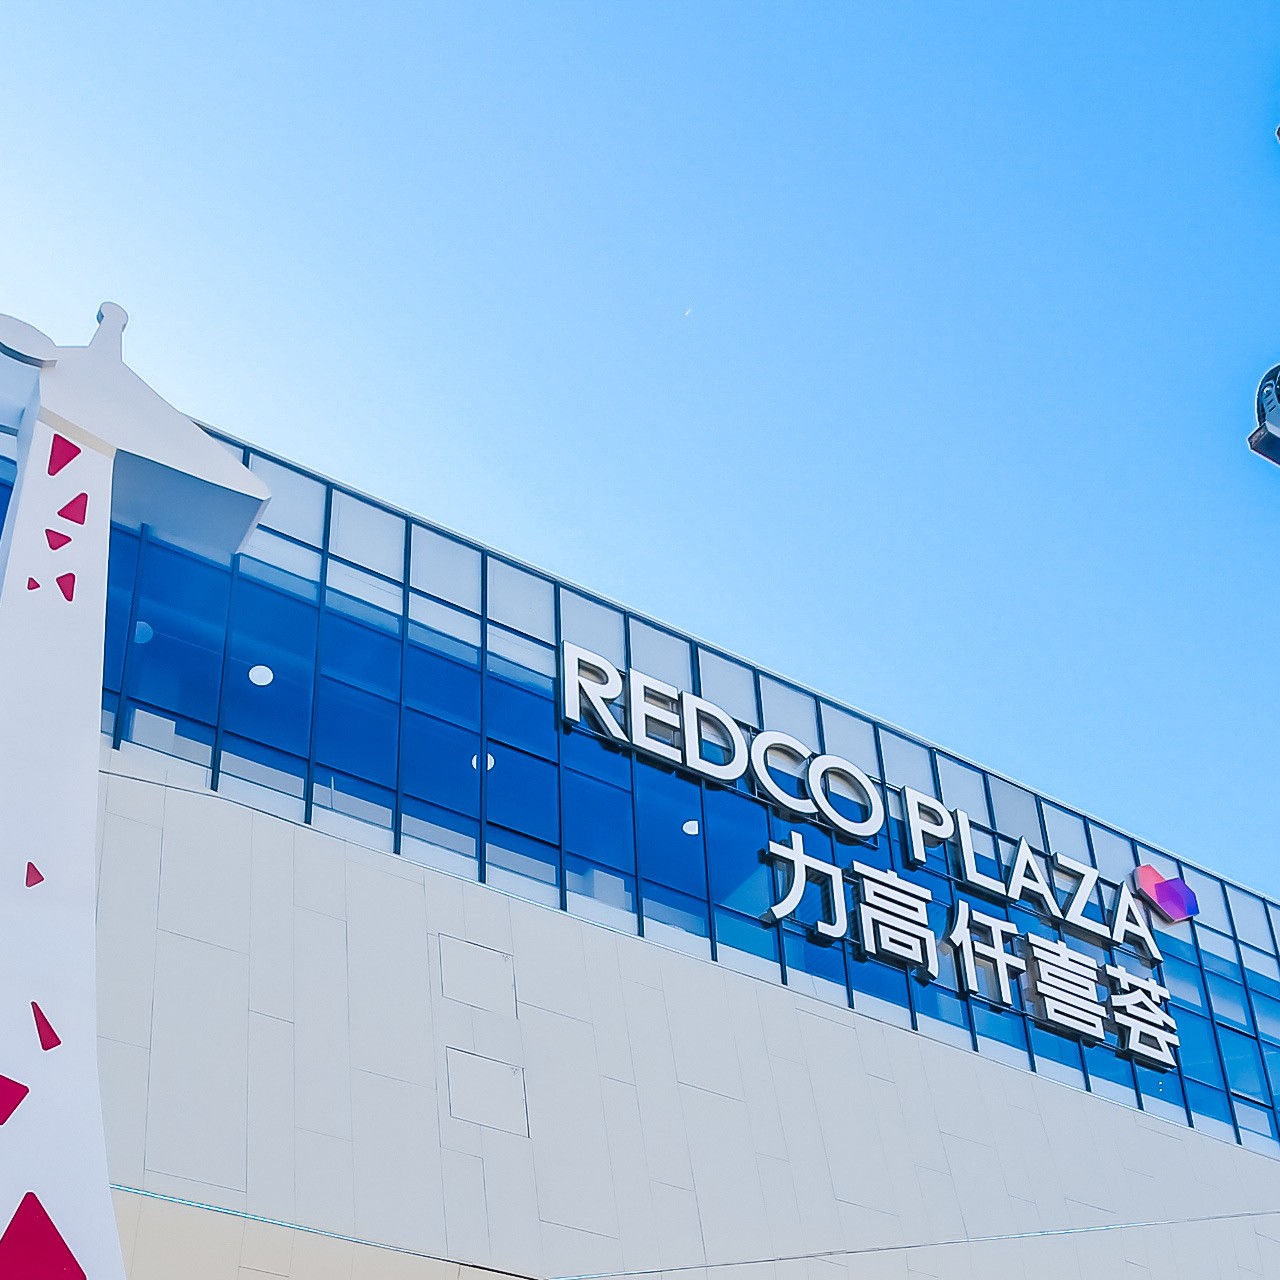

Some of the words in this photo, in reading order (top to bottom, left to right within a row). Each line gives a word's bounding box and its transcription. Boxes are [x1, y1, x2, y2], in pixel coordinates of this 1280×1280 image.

[561, 640, 885, 838] REDCO
[901, 785, 1164, 962] PLAZA
[766, 830, 1181, 1070] 力高仟喜荟
